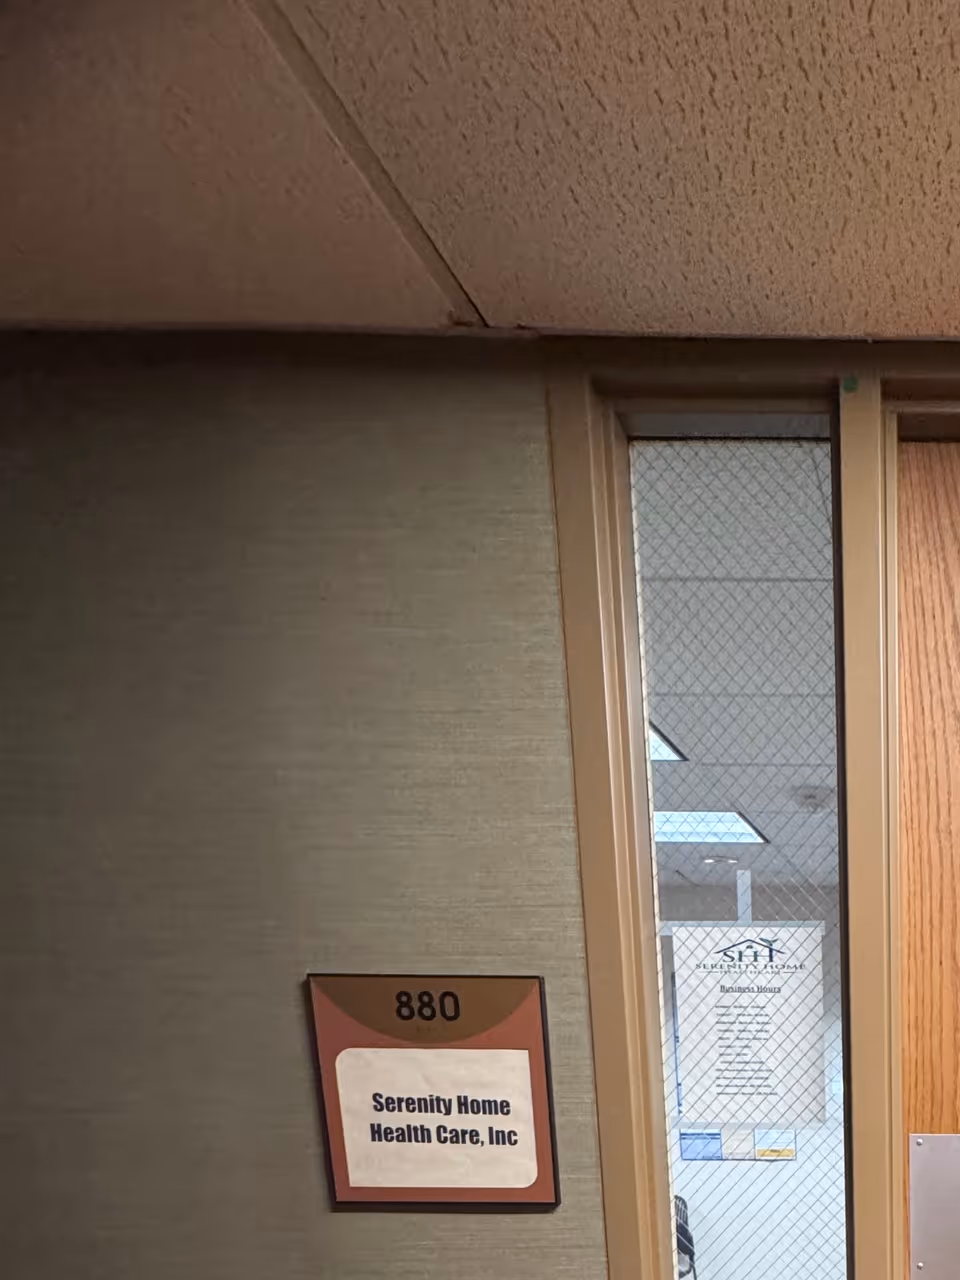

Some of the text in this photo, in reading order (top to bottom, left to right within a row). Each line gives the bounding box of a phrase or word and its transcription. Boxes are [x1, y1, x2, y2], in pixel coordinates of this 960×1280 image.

[720, 985, 782, 994] Business Hours
[395, 990, 461, 1022] 880
[372, 1092, 511, 1116] Serenity Home
[370, 1123, 519, 1147] Health Care, Inc
